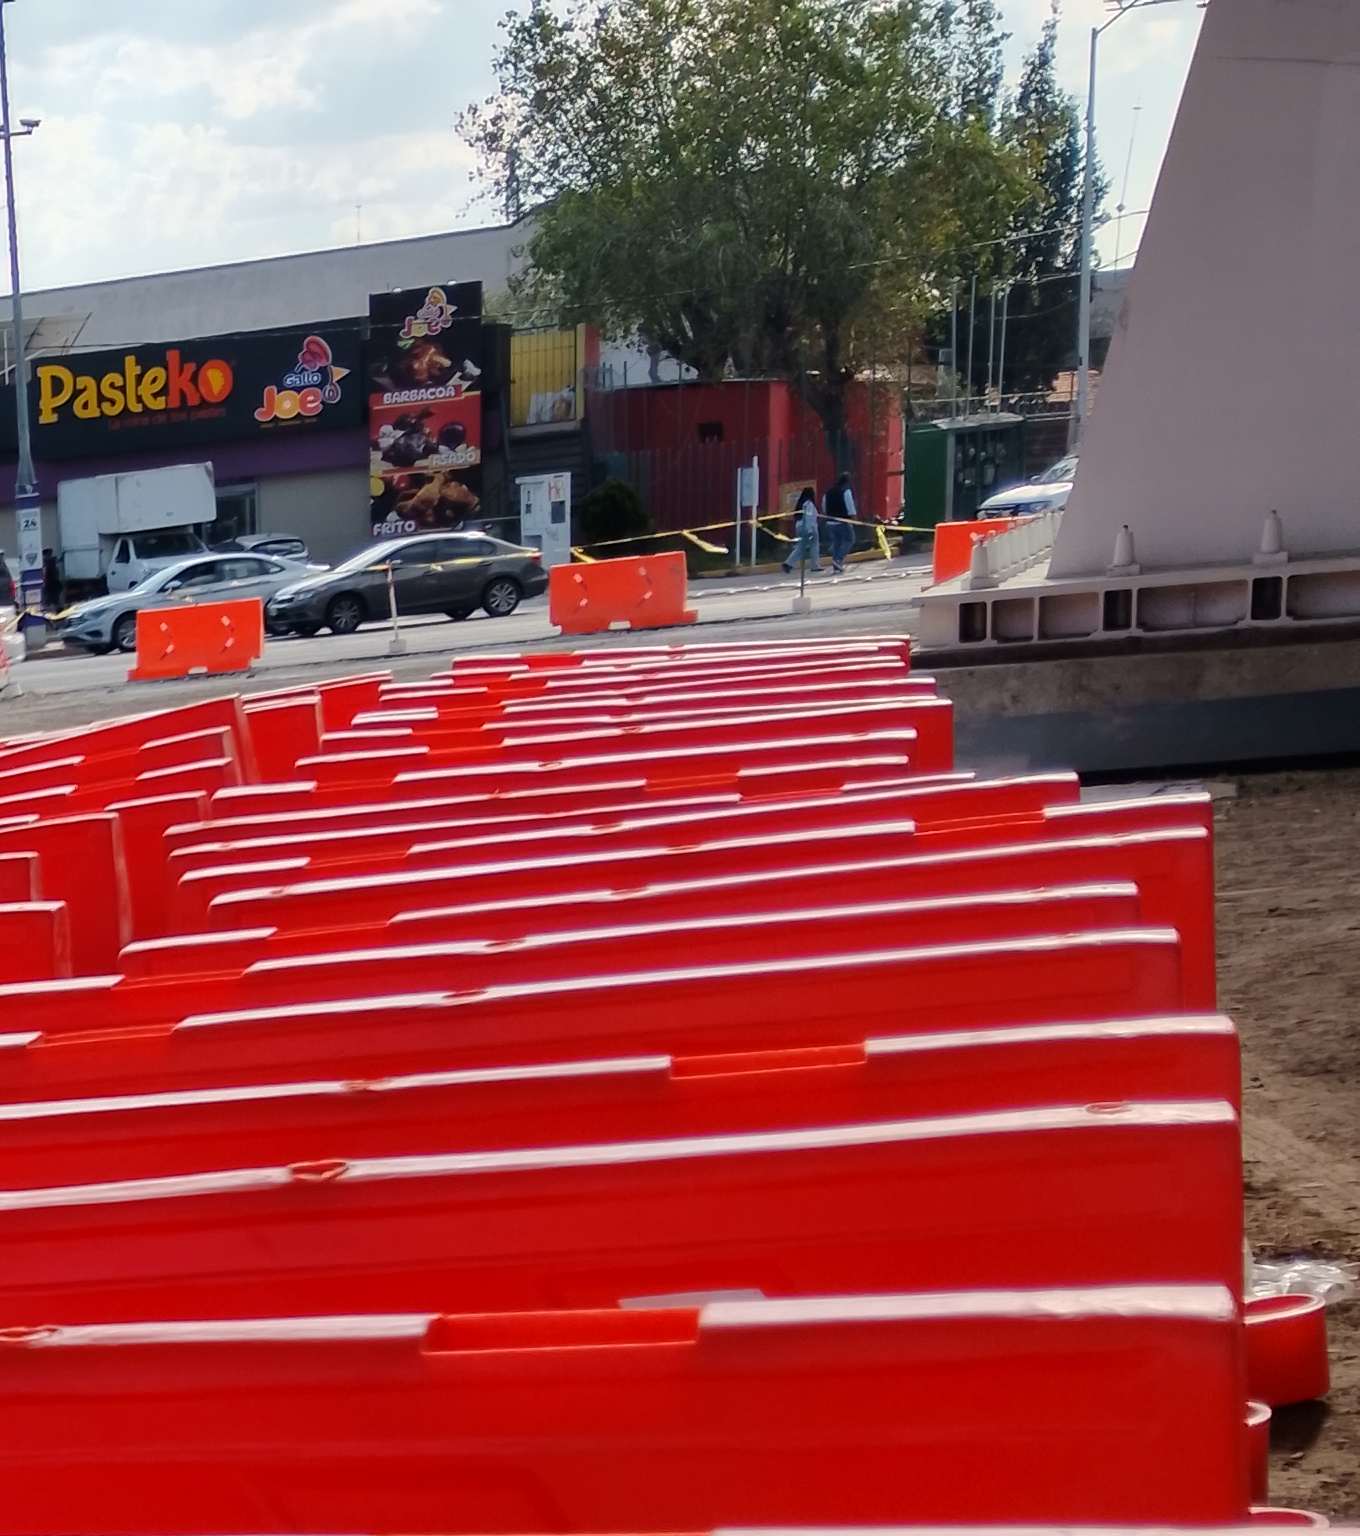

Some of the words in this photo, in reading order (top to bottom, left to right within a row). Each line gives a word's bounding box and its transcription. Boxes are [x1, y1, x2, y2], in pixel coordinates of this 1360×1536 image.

[37, 349, 233, 424] Pasteko
[283, 371, 321, 388] Gallo
[254, 385, 323, 421] Joe
[383, 386, 455, 404] BARBACOA
[433, 451, 476, 465] ASADO
[373, 520, 415, 536] FRITO
